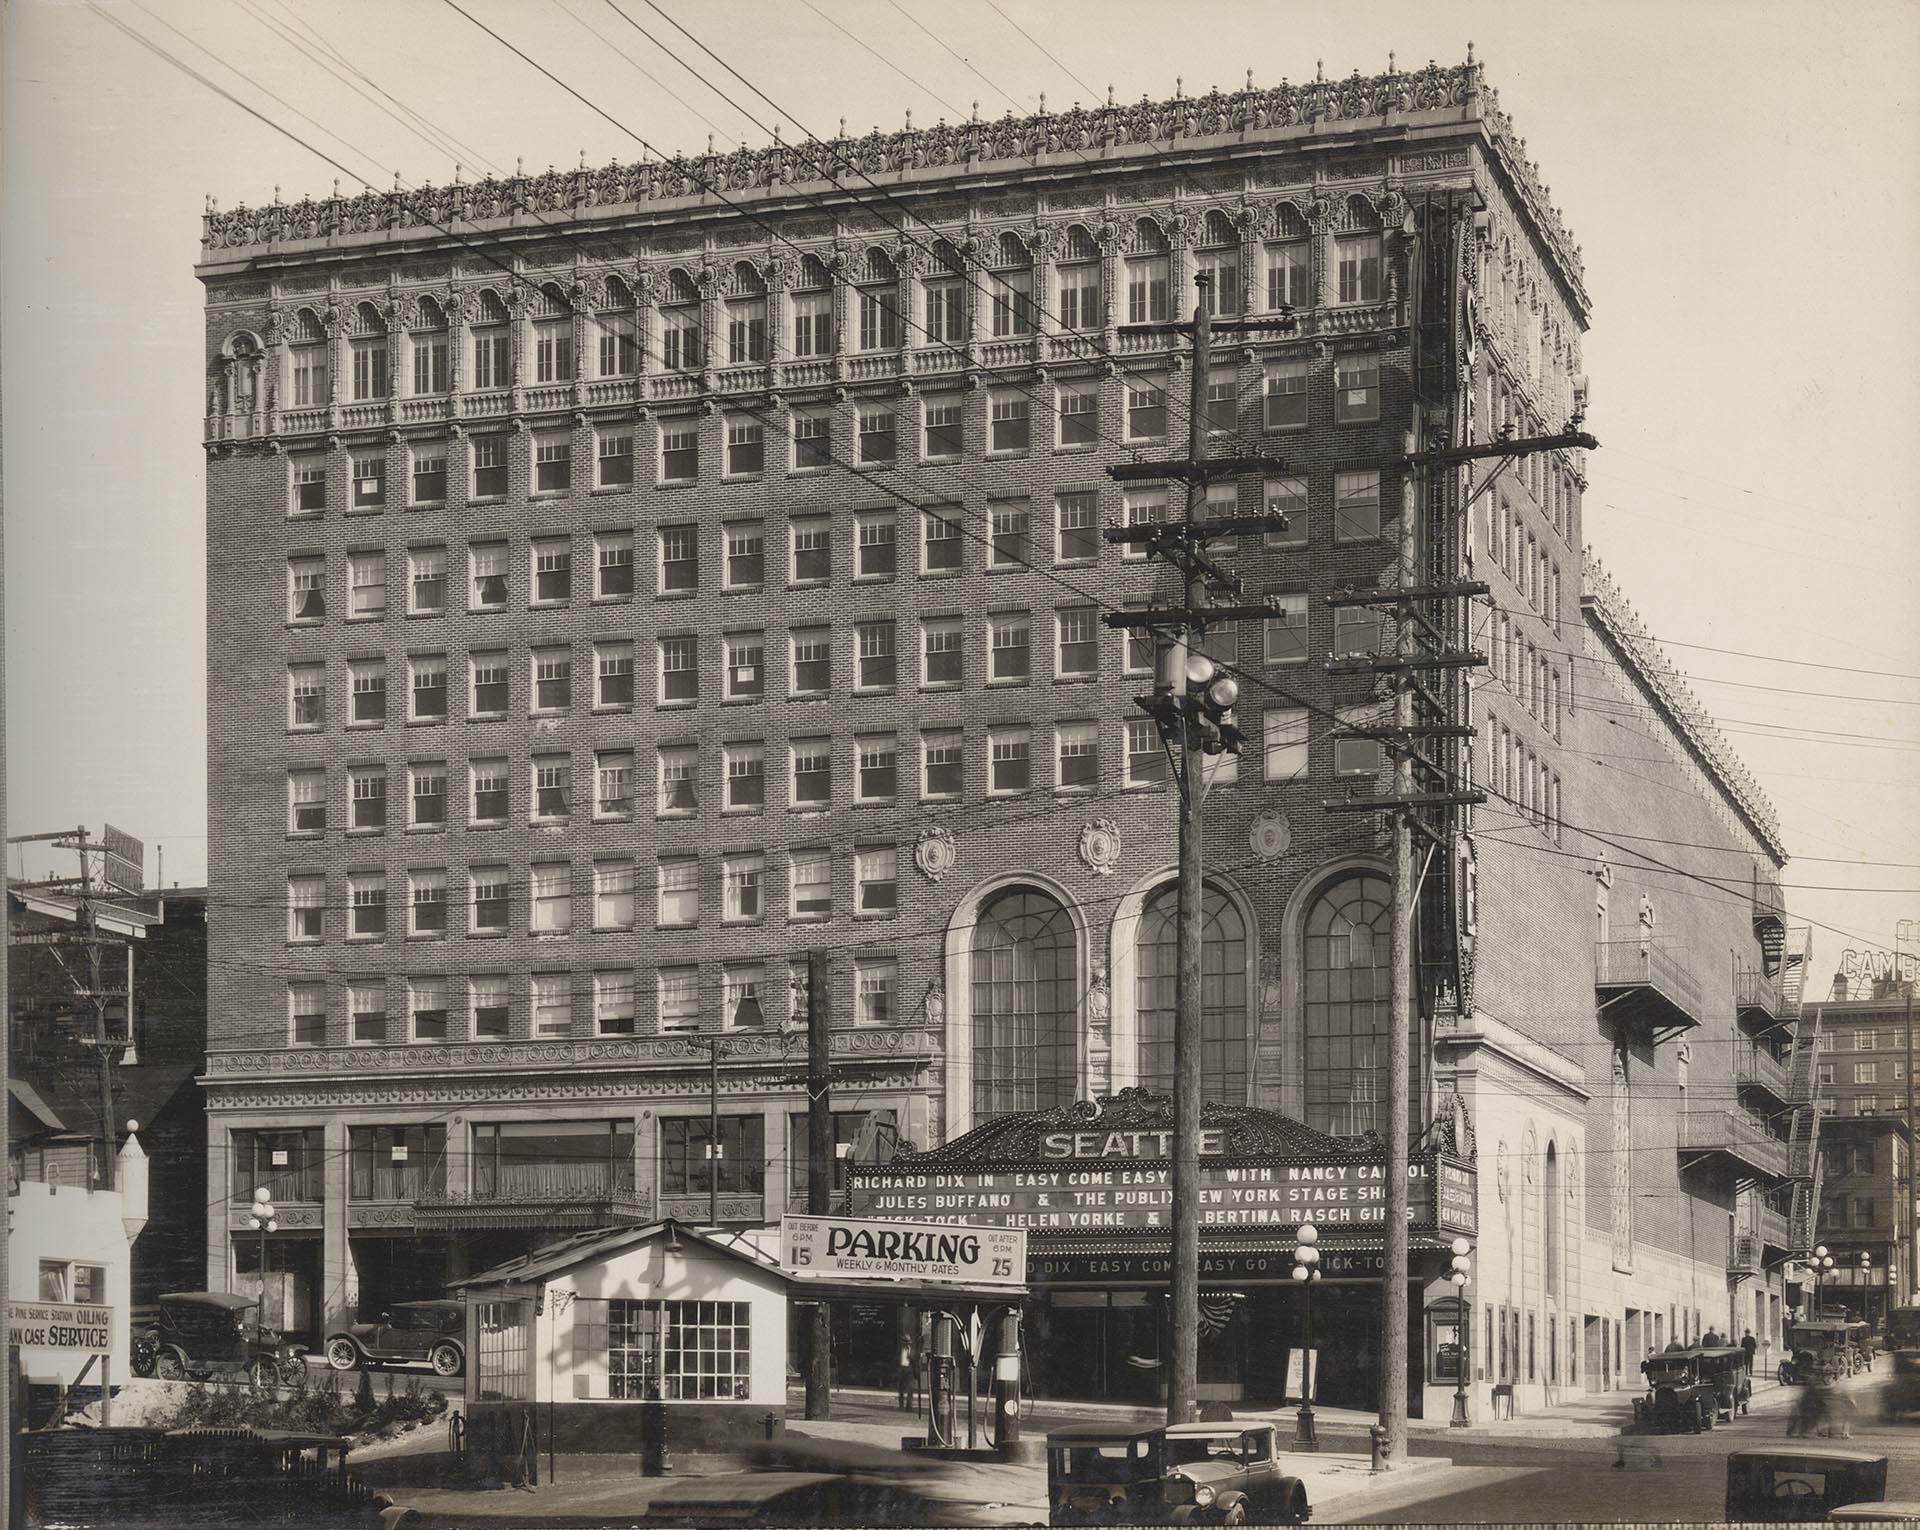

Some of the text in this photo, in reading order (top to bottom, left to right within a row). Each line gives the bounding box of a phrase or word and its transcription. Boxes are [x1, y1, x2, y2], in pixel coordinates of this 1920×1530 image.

[1044, 1129, 1225, 1159] SEATTE
[853, 1175, 927, 1190] RICHARD
[936, 1174, 965, 1188] DIX
[978, 1174, 994, 1188] IN
[1068, 1171, 1113, 1185] COME
[1122, 1170, 1167, 1184] EASY
[1226, 1168, 1271, 1182] WITH
[1288, 1166, 1347, 1181] NANCY
[1357, 1164, 1429, 1179] CAOL
[875, 1195, 928, 1210] JULES
[935, 1194, 1011, 1209] BUFFANO
[1037, 1194, 1050, 1207] &
[1074, 1192, 1107, 1206] THE
[1199, 1190, 1222, 1204] EW
[1232, 1188, 1280, 1203] YORK
[1289, 1187, 1349, 1201] STAGE
[1357, 1186, 1386, 1200] SH
[787, 1222, 798, 1231] OUT
[1005, 1212, 1060, 1227] HELEN
[1069, 1211, 1126, 1226] YORKE
[1147, 1212, 1160, 1225] &
[1197, 1207, 1281, 1224] BERTINA
[1290, 1207, 1351, 1222] RASCH
[1360, 1206, 1415, 1221] GIRS
[826, 1226, 981, 1265] PARKING
[791, 1246, 812, 1266] 15
[836, 1258, 872, 1271] WEEKLY
[884, 1262, 928, 1274] MONTHLY
[932, 1264, 959, 1275] RATES
[991, 1257, 1012, 1277] 25
[1044, 1261, 1071, 1273] DIX
[1141, 1260, 1172, 1272] COM
[29, 1307, 49, 1321] SERVICE
[51, 1309, 73, 1322] STATION
[76, 1310, 109, 1326] OILING
[24, 1328, 46, 1345] CASE
[48, 1325, 109, 1348] SERVICE
